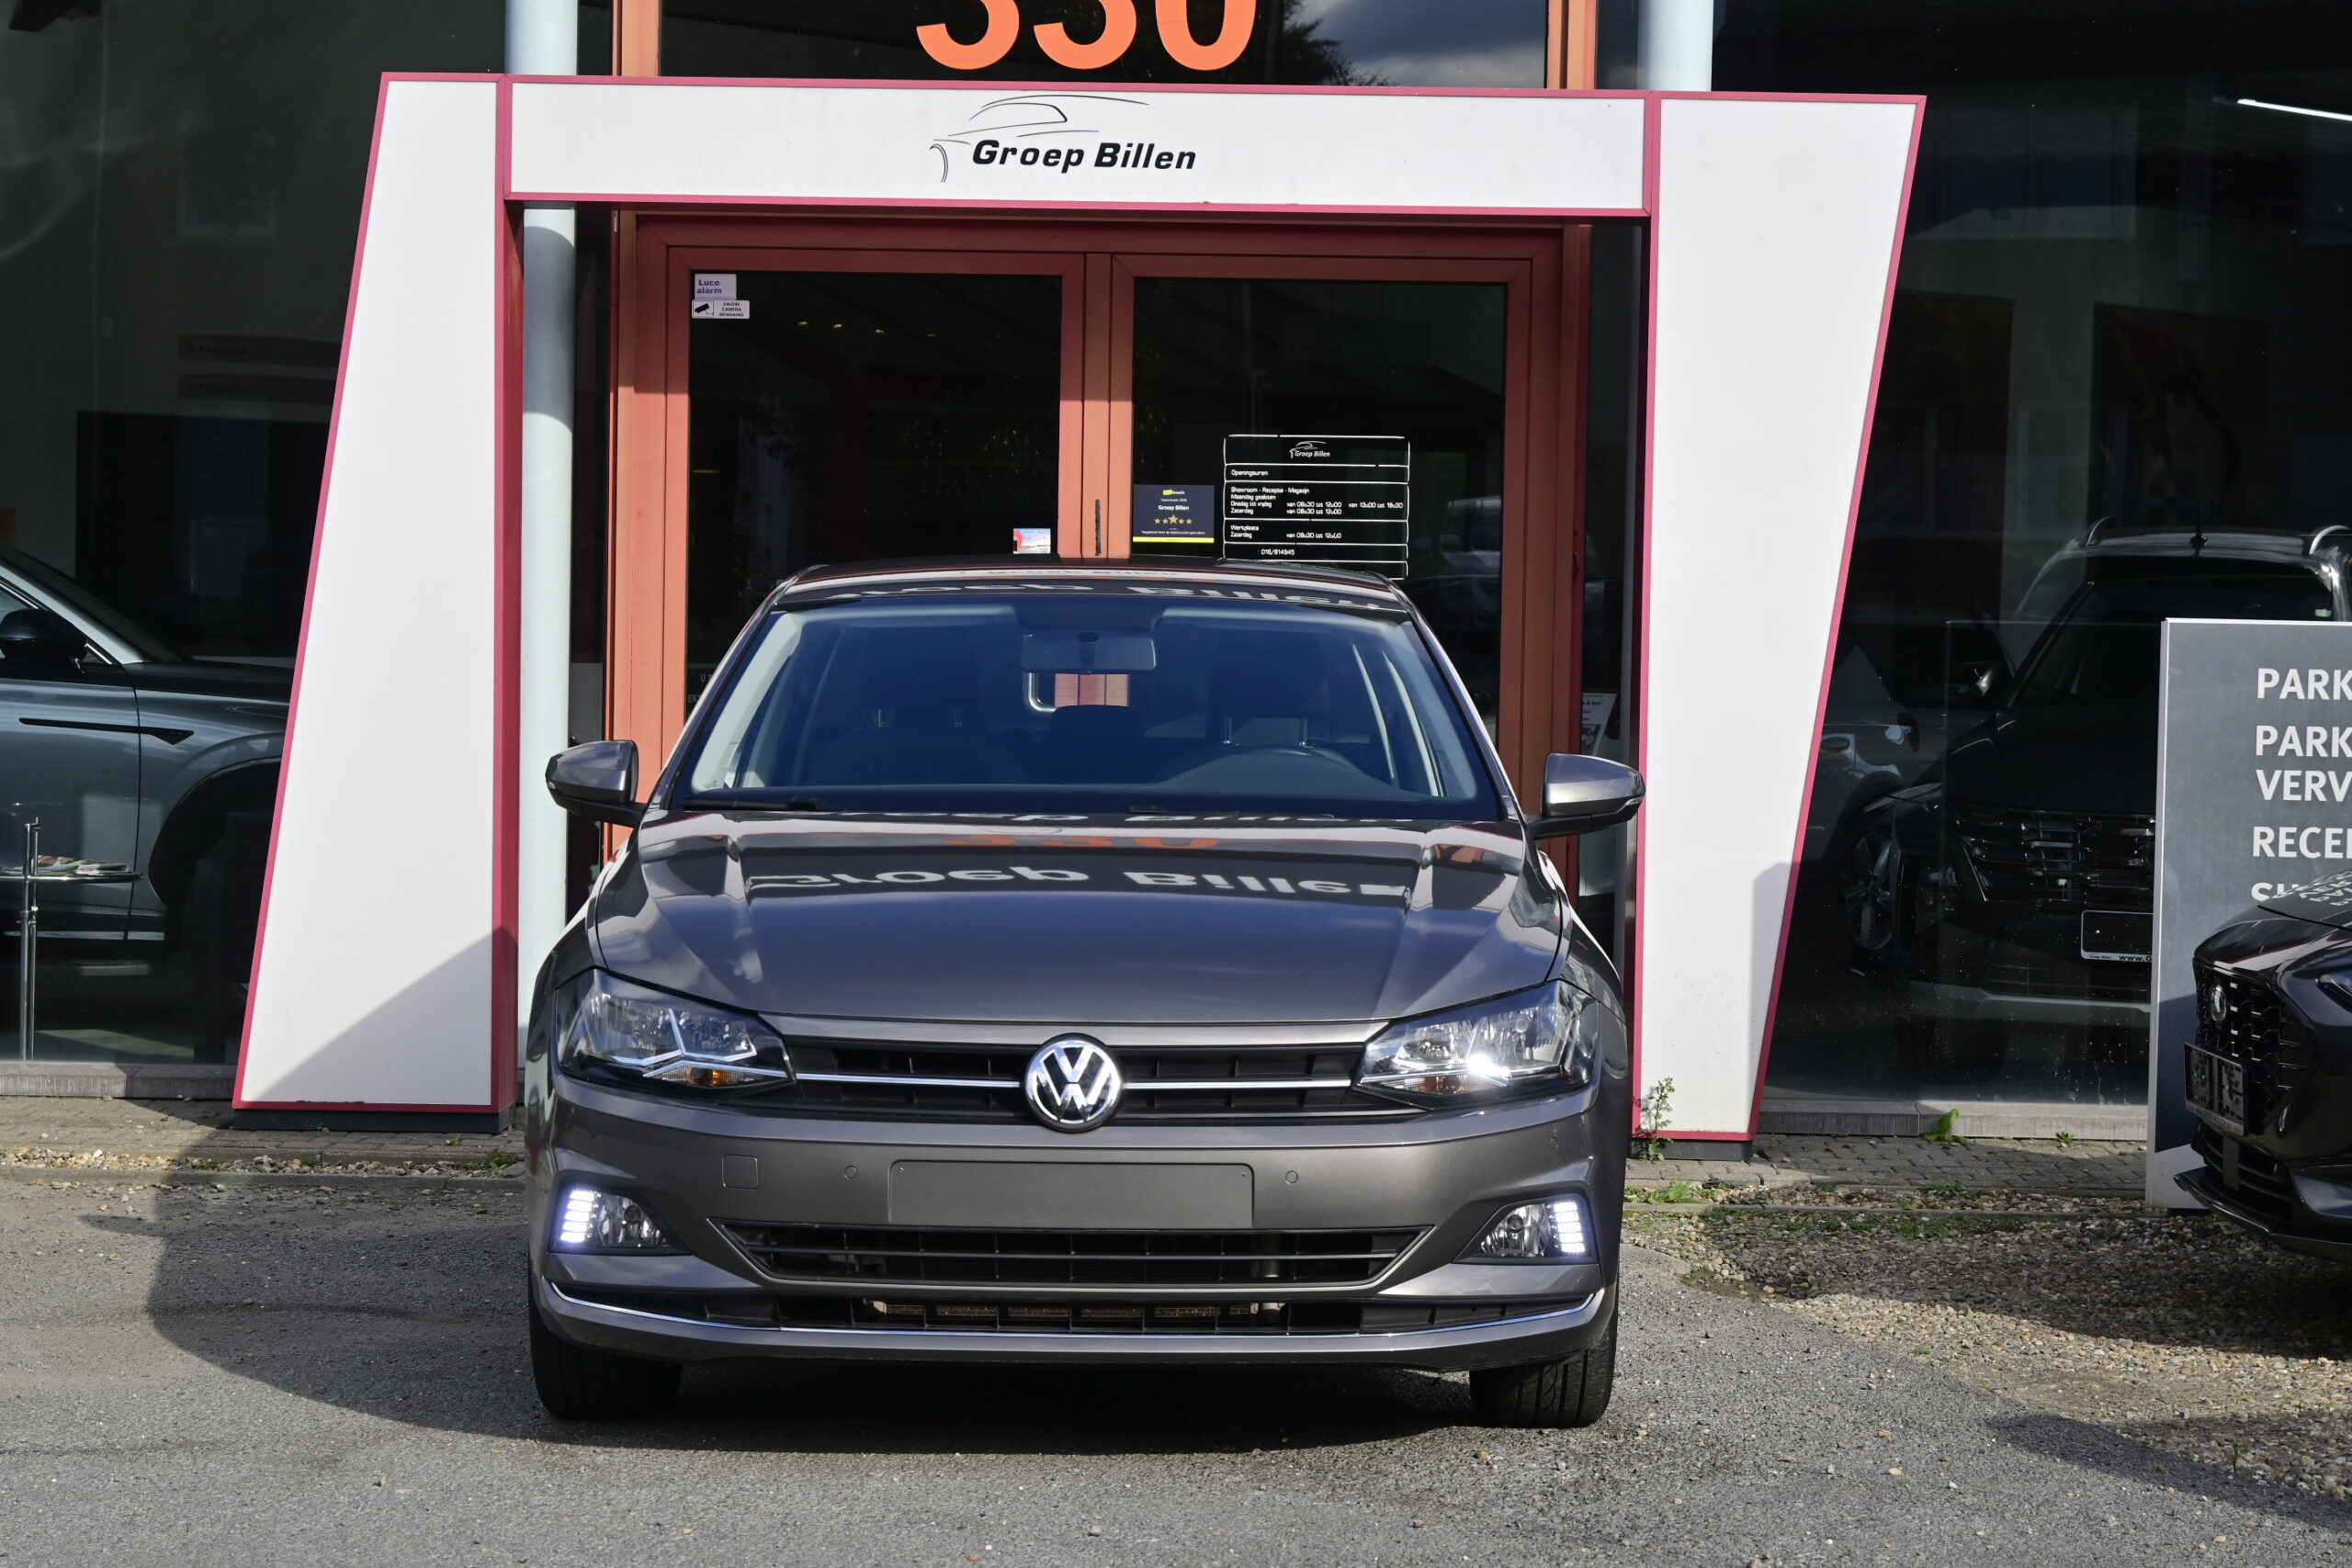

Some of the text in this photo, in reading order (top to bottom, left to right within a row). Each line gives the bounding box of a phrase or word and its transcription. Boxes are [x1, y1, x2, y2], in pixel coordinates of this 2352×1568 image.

[972, 139, 1196, 175] Groep Billen
[1295, 450, 1313, 458] Groep
[2256, 668, 2352, 701] PARK
[2256, 725, 2352, 758] PARK
[2256, 769, 2352, 802] VERV
[2253, 826, 2352, 859] RECE
